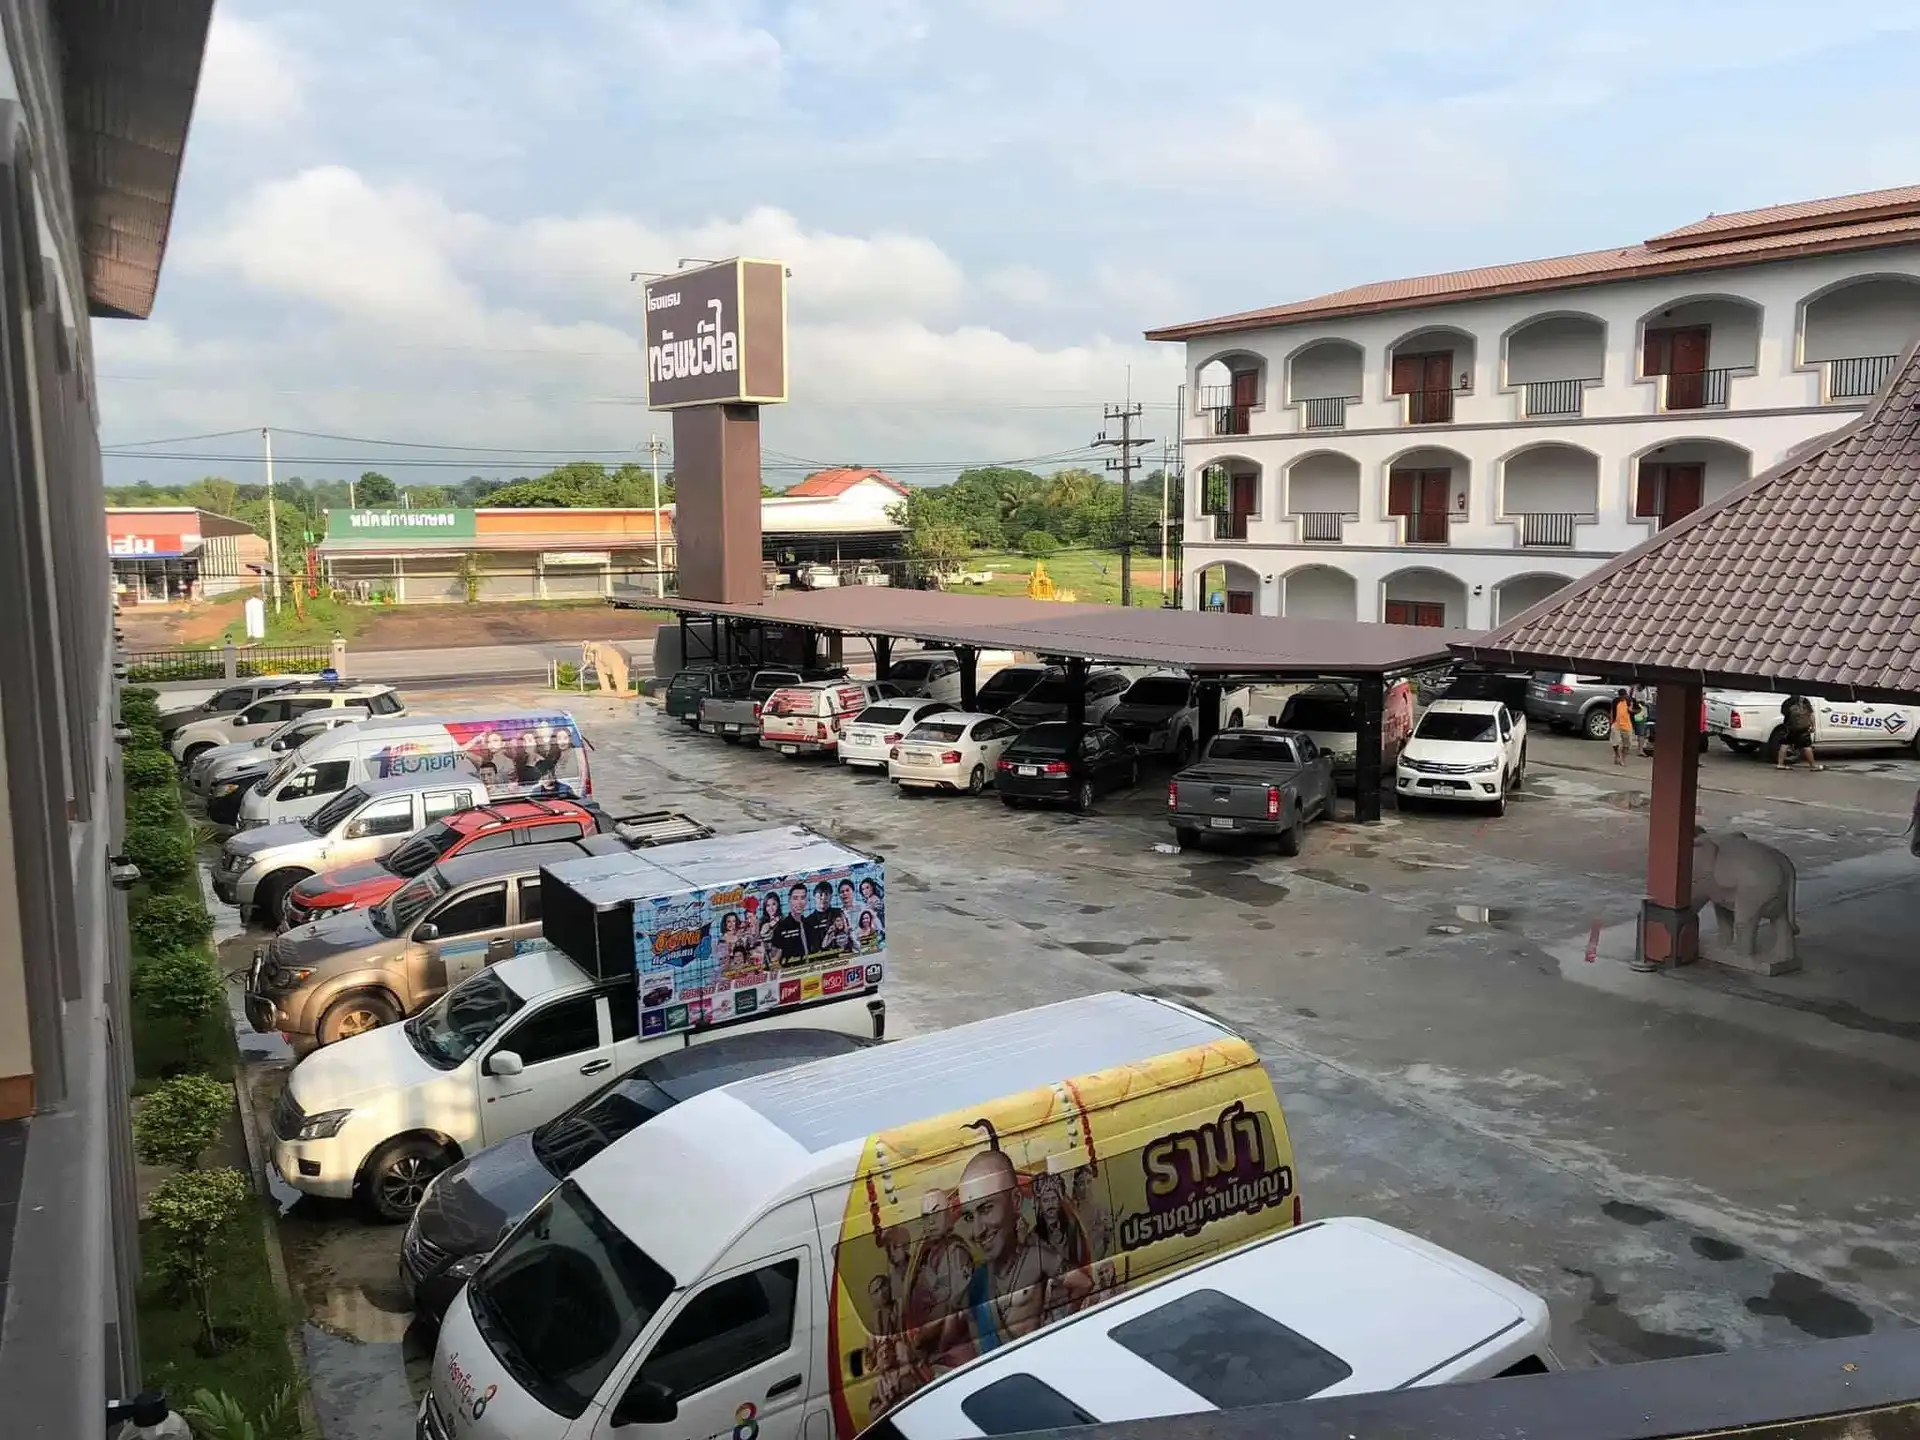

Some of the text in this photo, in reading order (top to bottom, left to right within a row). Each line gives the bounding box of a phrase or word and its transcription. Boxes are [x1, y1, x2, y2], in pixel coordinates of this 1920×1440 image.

[646, 288, 681, 312] โรงแรม
[1849, 715, 1883, 728] PLUS
[1123, 1169, 1290, 1246] ปราชญ์เจ้าปัญญา
